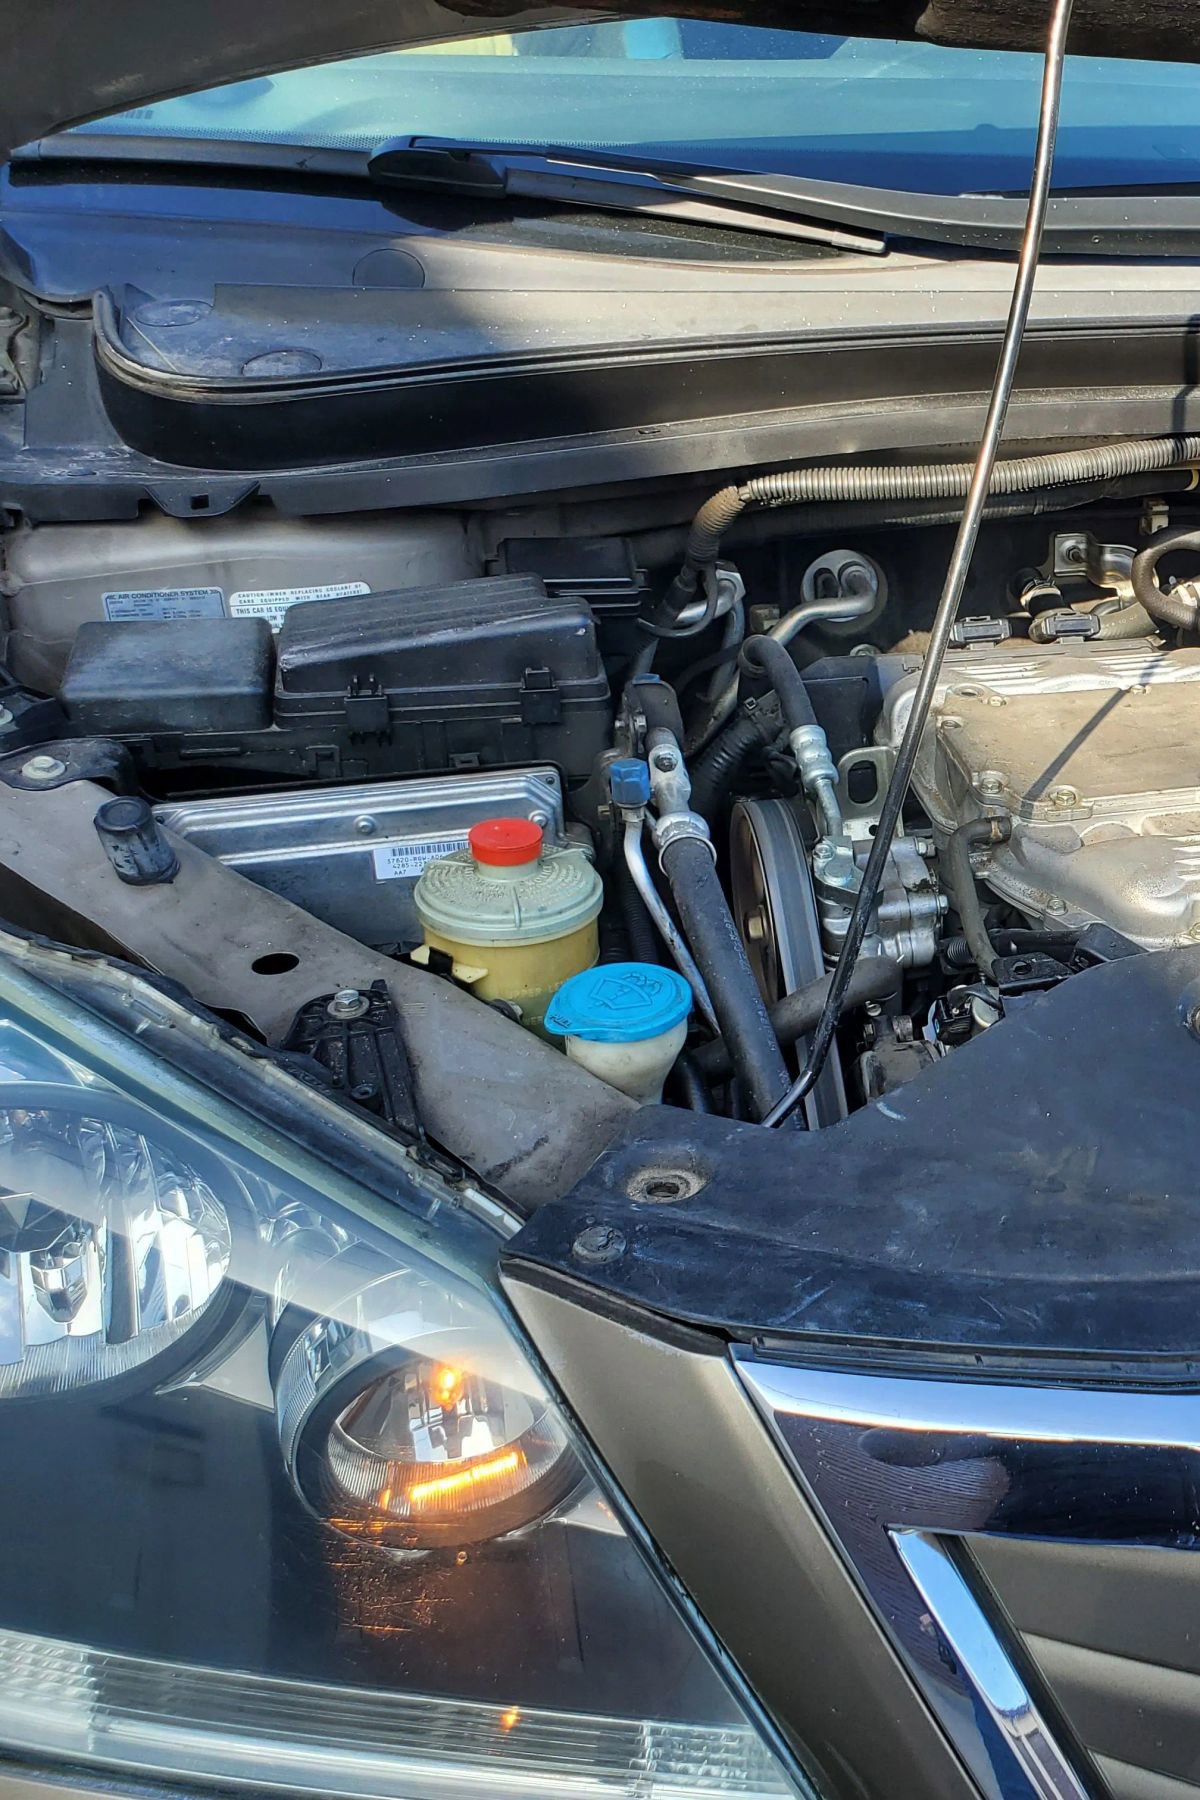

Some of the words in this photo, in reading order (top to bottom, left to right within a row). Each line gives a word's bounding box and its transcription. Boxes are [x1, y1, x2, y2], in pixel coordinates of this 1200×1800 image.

[131, 591, 179, 599] CONDITIONER
[180, 589, 209, 597] SYSTEM
[236, 607, 251, 615] THIS
